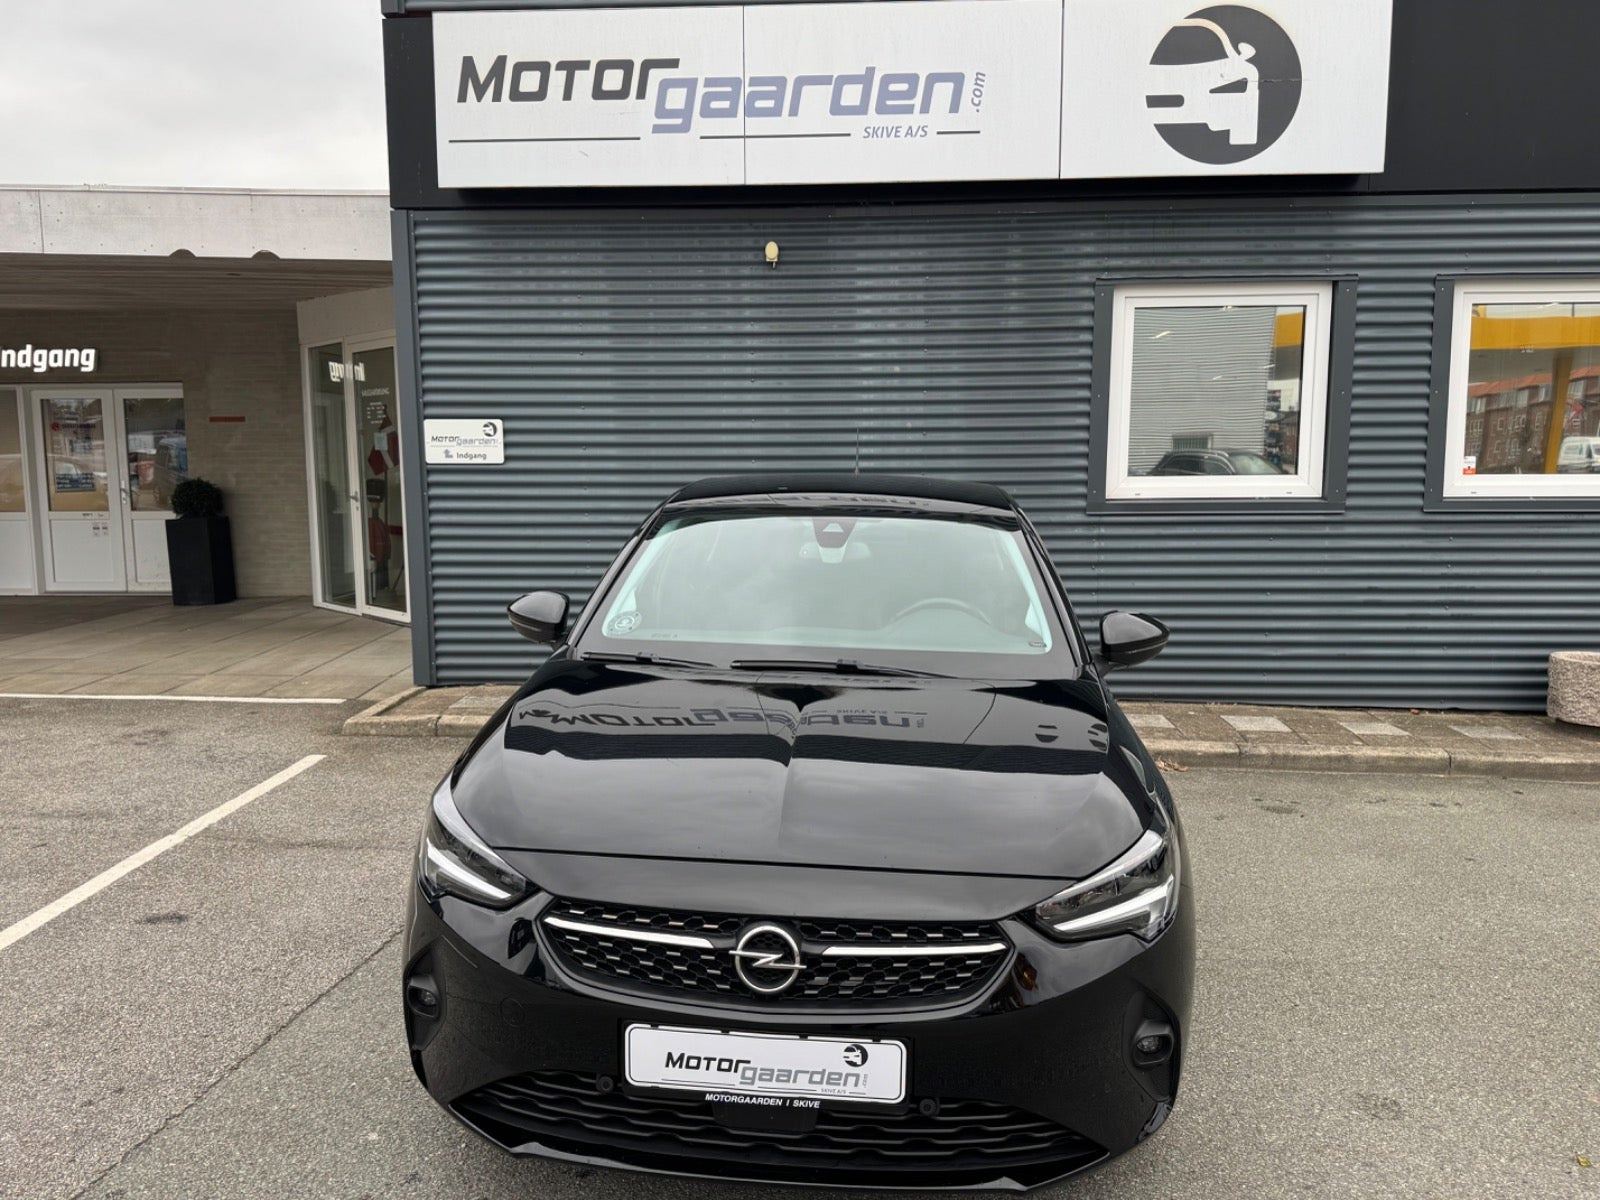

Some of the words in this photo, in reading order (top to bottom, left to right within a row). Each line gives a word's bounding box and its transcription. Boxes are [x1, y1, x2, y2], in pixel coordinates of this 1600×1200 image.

[970, 71, 987, 113] .com
[862, 125, 902, 139] SKIVE
[904, 124, 929, 138] A/S
[0, 344, 96, 373] ndgang
[456, 452, 487, 460] Indgang
[704, 1093, 783, 1106] MOTORGAARDEN
[792, 1099, 821, 1109] SKIVE
